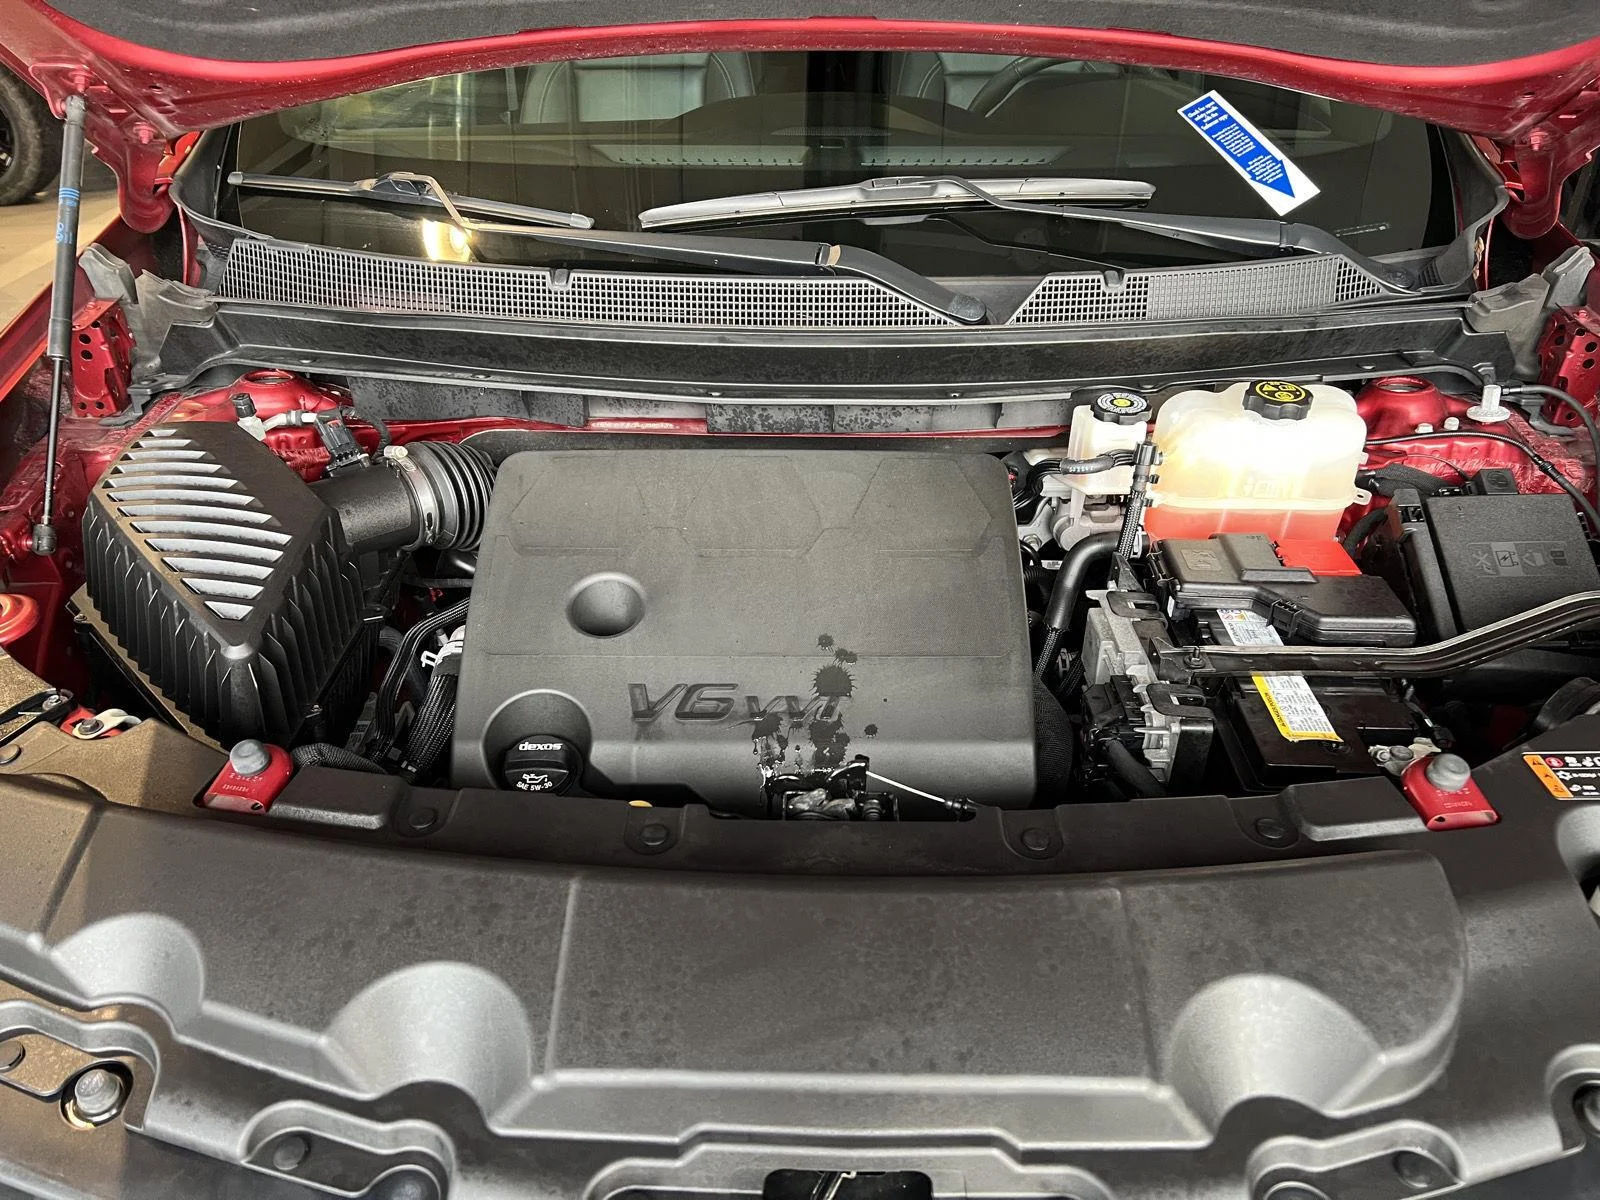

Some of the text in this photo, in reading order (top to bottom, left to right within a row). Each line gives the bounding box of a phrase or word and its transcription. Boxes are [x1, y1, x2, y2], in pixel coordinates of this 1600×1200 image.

[627, 683, 739, 722] V6
[518, 741, 563, 751] dexos
[516, 781, 553, 791] SAE 5W-30
